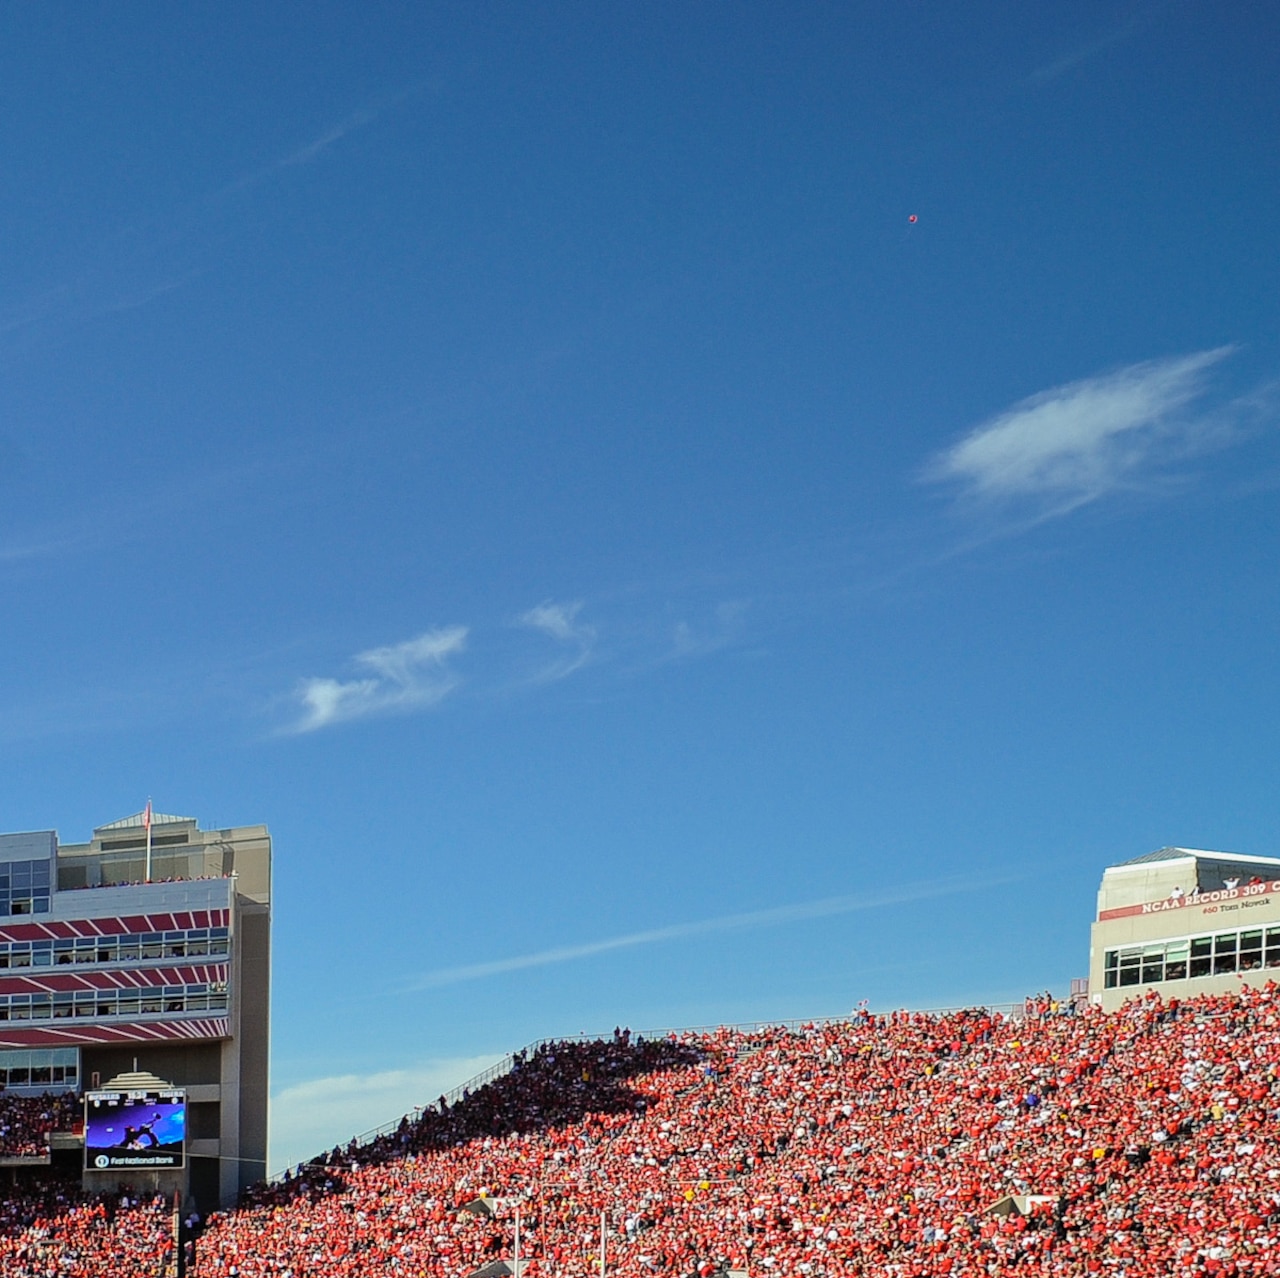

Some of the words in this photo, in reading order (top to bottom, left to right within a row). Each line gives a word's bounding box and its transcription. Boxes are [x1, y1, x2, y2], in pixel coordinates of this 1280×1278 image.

[1142, 899, 1180, 914] NCAA
[1184, 888, 1238, 906] RECORD
[1243, 882, 1266, 896] 309
